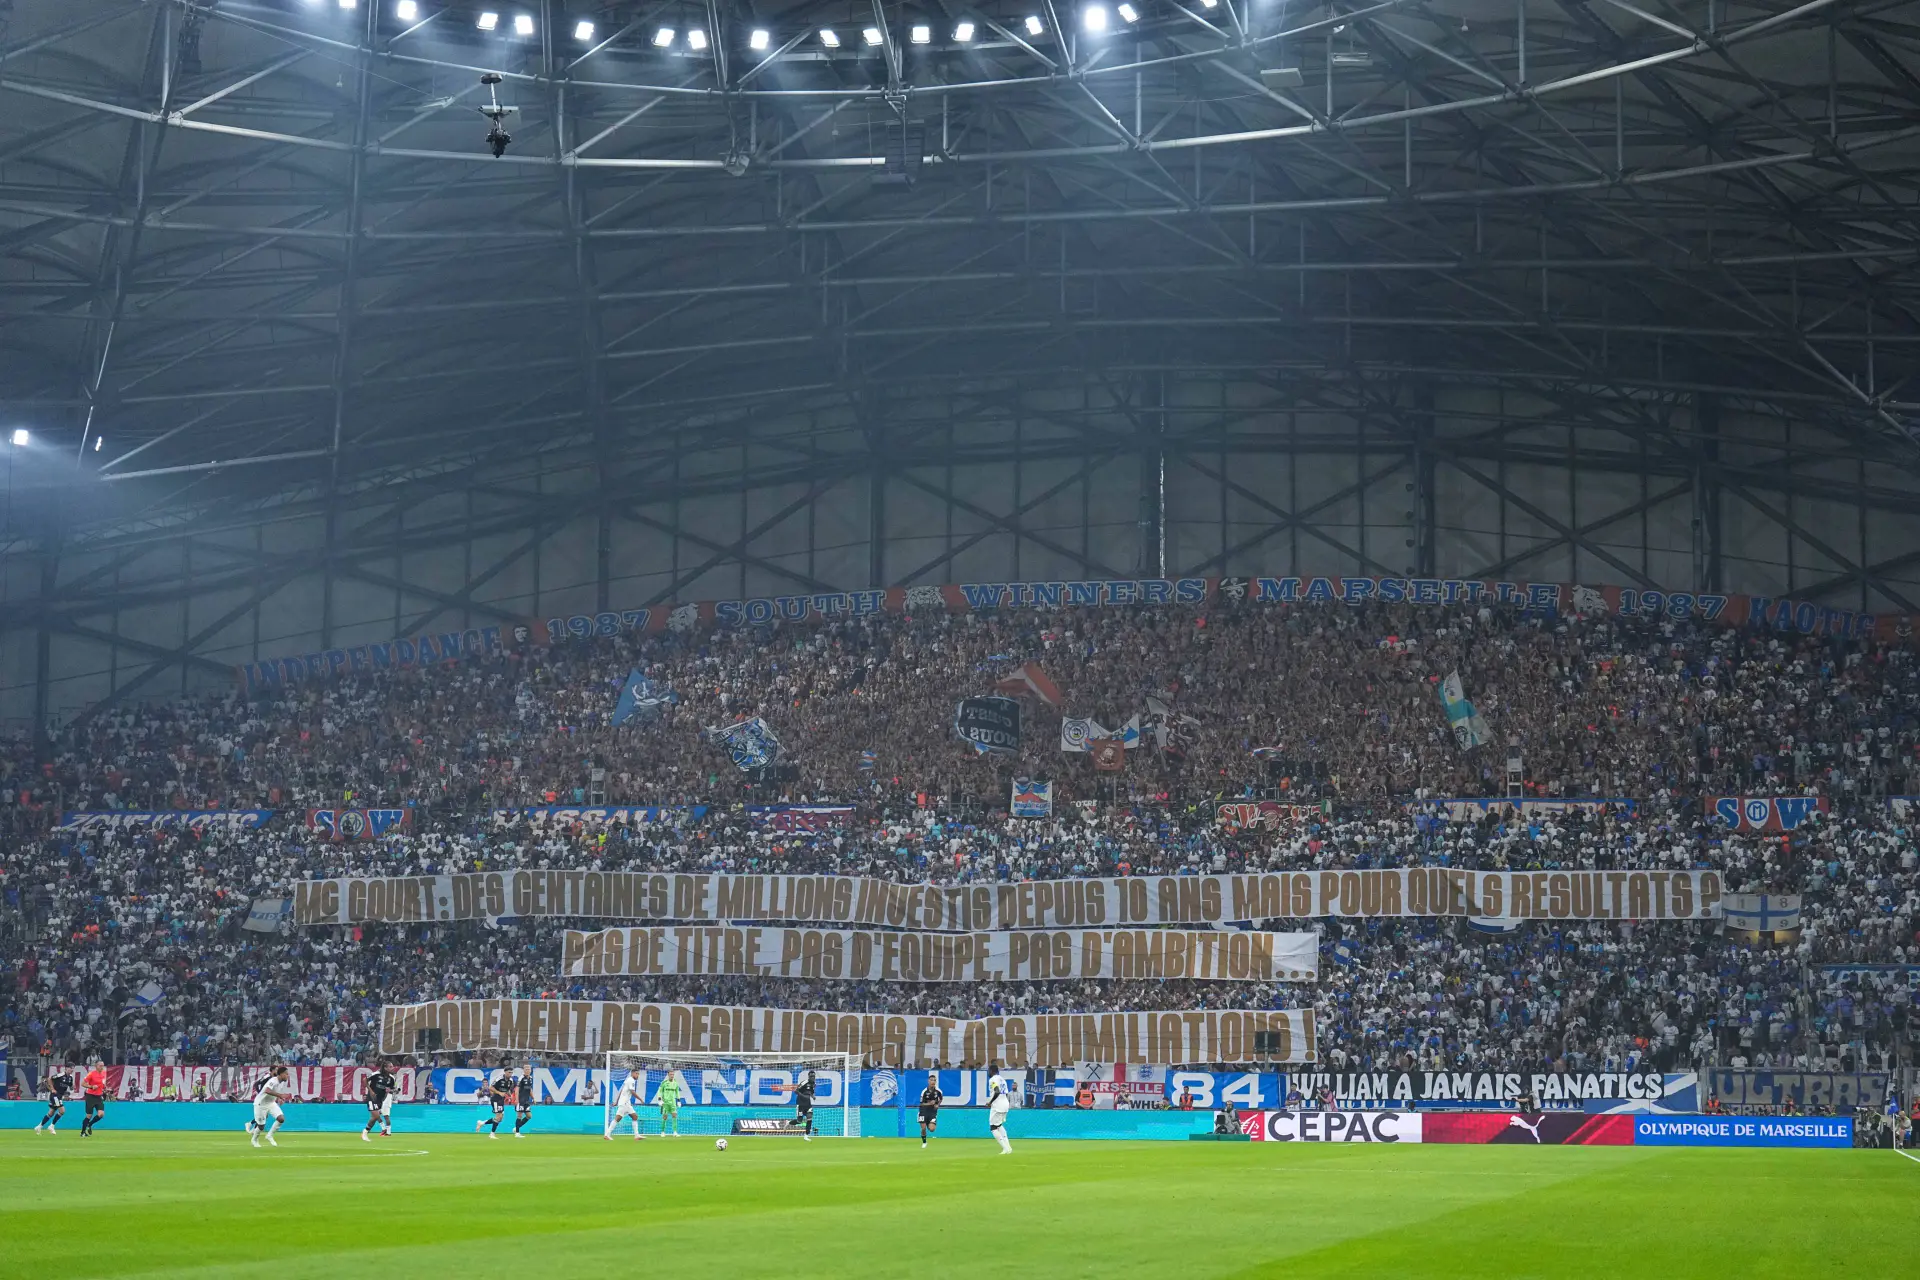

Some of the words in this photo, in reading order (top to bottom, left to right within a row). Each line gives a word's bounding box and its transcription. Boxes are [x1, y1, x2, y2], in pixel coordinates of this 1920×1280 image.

[547, 609, 651, 644] 1987
[715, 590, 887, 627] SOUTH
[960, 578, 1207, 608] WINNERS
[1257, 577, 1560, 612] MARSEILLE
[1618, 589, 1728, 620] 1987
[452, 876, 505, 919] DES
[513, 871, 667, 919] CENTAINES
[674, 874, 709, 920] DE
[716, 876, 852, 921] MILLIONS
[854, 879, 992, 930] INVESTIS
[998, 880, 1106, 926] DEPUIS
[1114, 879, 1148, 922] 10
[1158, 878, 1221, 922] ANS
[1232, 873, 1311, 920] MAIS
[1320, 871, 1402, 916] POUR
[1408, 868, 1502, 917] QUELS
[1510, 872, 1692, 918] RESULTATS
[565, 930, 626, 975] PAS
[628, 928, 664, 974] DE
[782, 930, 842, 978] PAS
[1009, 932, 1072, 980] PAS
[601, 1003, 660, 1051] DES
[670, 1004, 906, 1066] DESILLUSIONS
[914, 1017, 956, 1068] ET
[964, 1017, 1026, 1067] DES
[1036, 1011, 1291, 1067] HUMILIATIONS
[118, 1065, 161, 1100] AU
[335, 1066, 416, 1101] LOO
[1171, 1072, 1264, 1108] 84
[1393, 1073, 1414, 1100] A
[1420, 1073, 1521, 1100] JAMAIS
[1531, 1072, 1662, 1100] FANATICS
[1716, 1073, 1885, 1106] ULTRAS
[739, 1119, 780, 1129] UNIBET
[1268, 1112, 1400, 1142] CEPAC
[1639, 1122, 1730, 1137] OLYMPIQUE
[1734, 1123, 1755, 1137] DE
[1759, 1124, 1848, 1138] MARSEILLE
